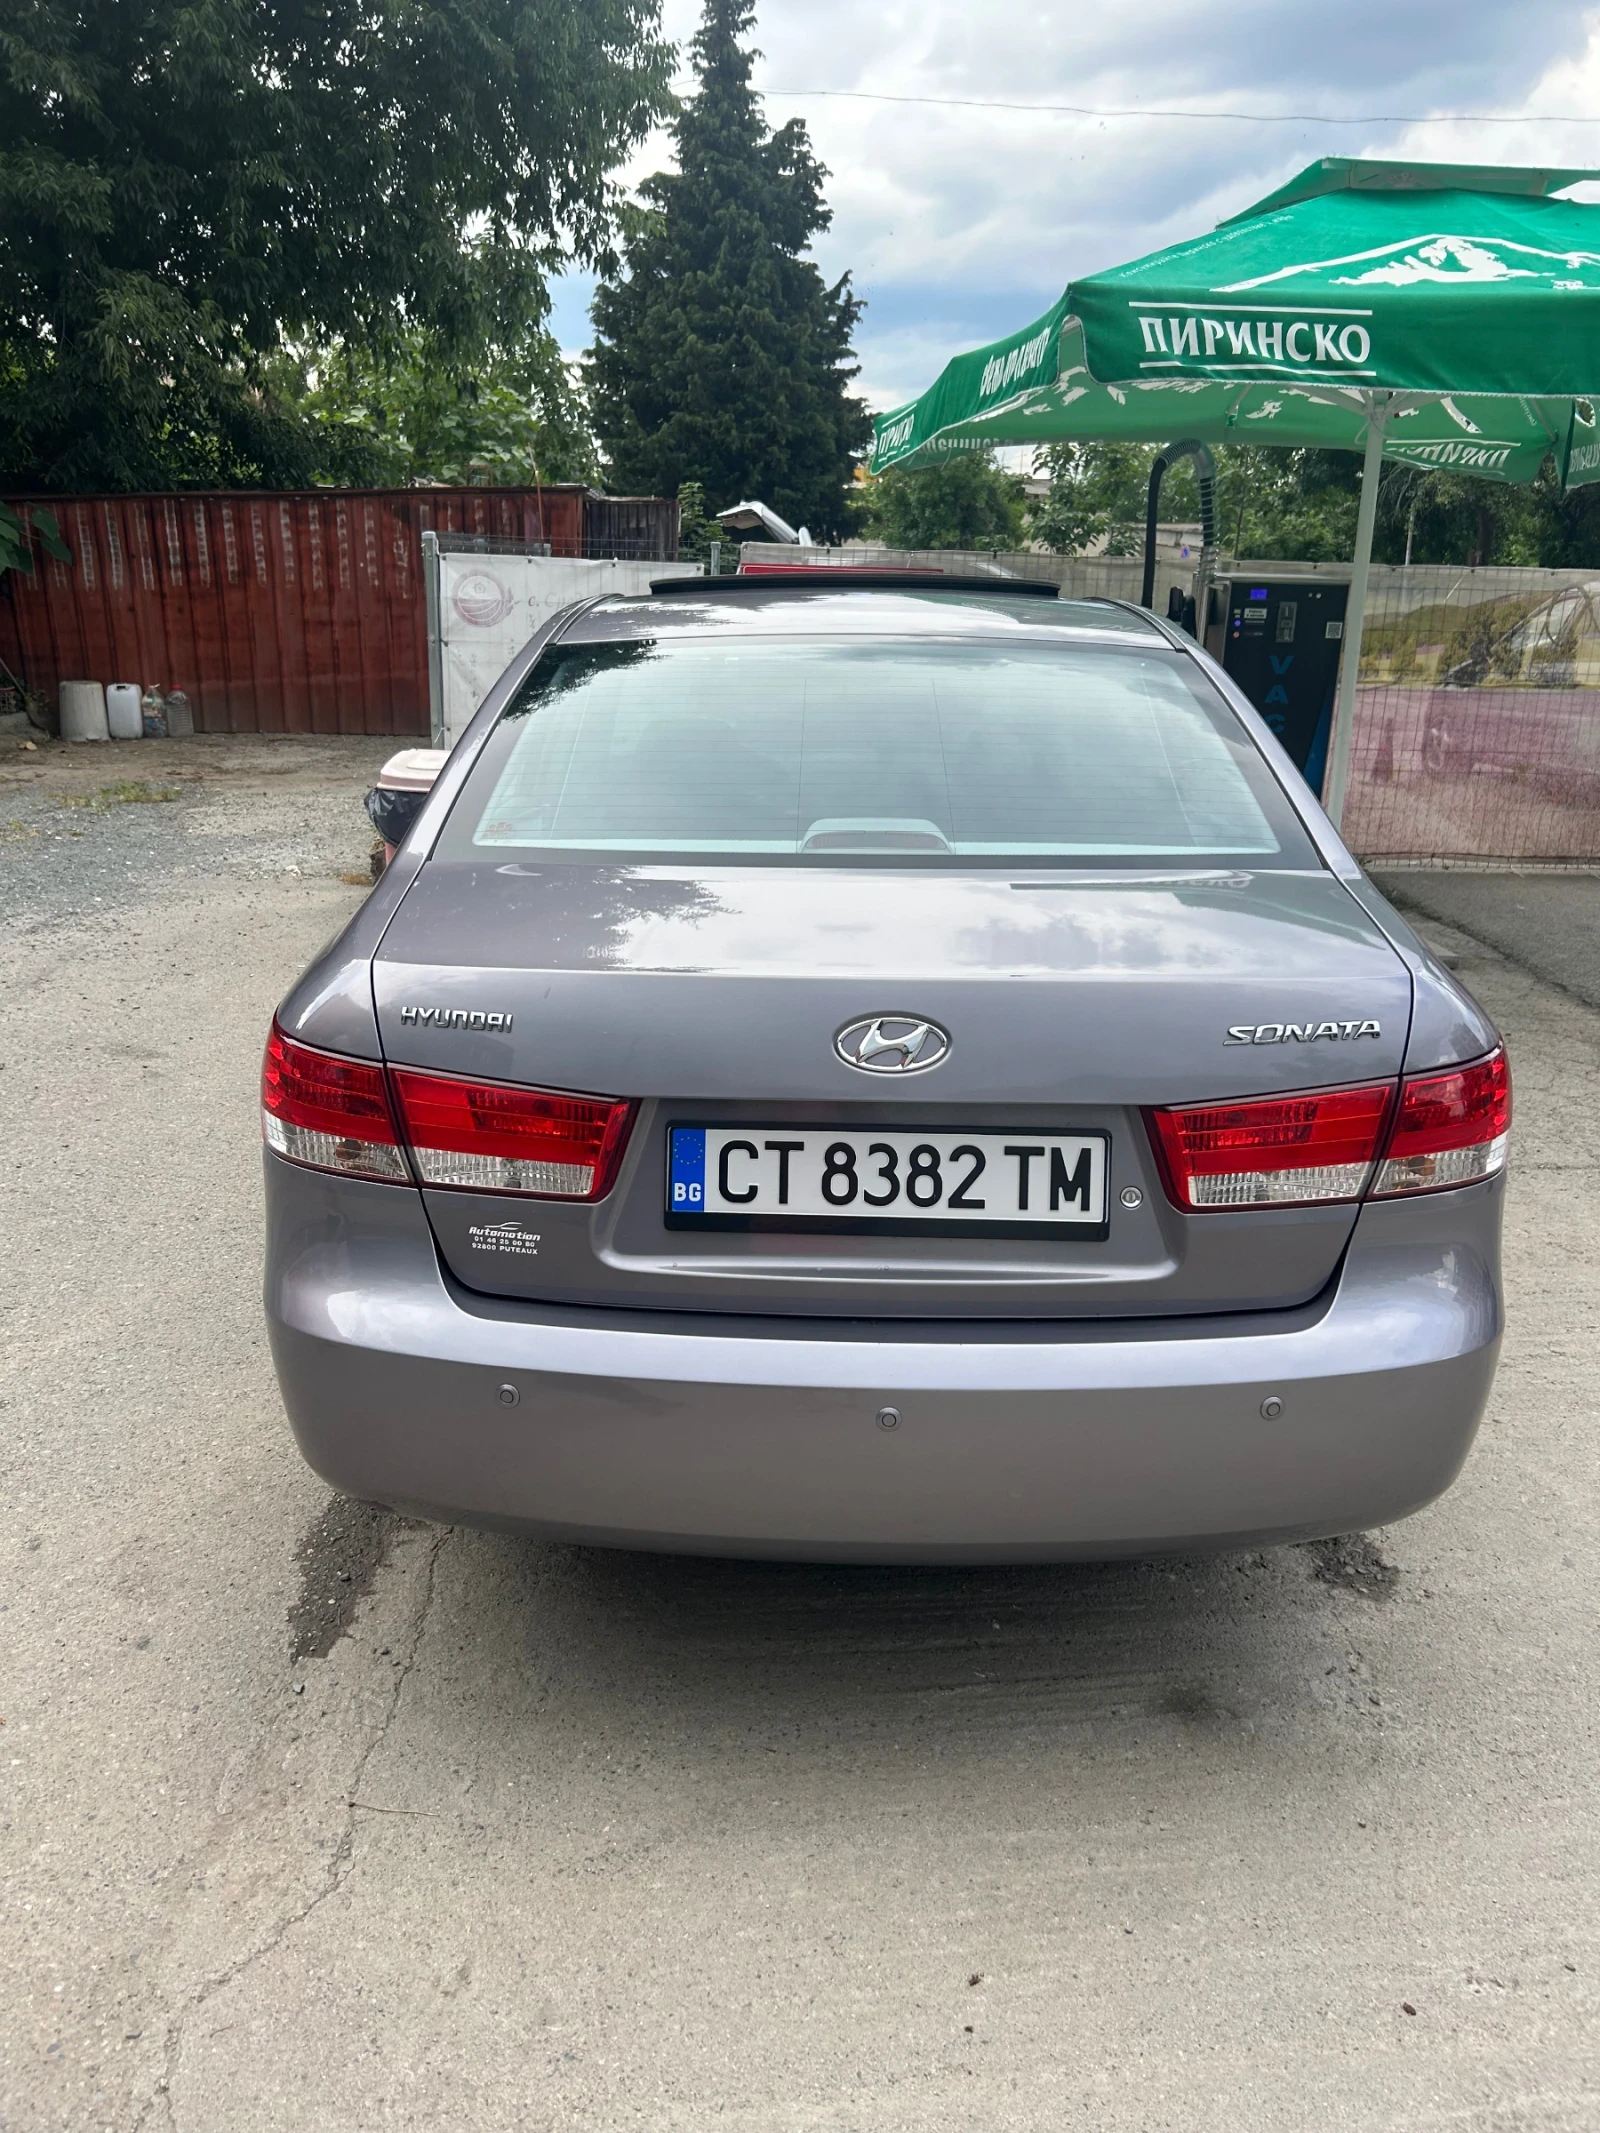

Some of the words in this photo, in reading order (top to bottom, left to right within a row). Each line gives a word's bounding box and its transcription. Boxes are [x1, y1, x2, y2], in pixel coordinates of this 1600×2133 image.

[1138, 316, 1371, 363] ПИРИНСКО
[401, 1006, 513, 1033] HYUNDAI
[1223, 1020, 1381, 1046] SONATA
[718, 1140, 805, 1205] CT
[821, 1142, 987, 1209] 8382
[1004, 1145, 1092, 1212] TM
[674, 1182, 702, 1202] BG
[469, 1226, 541, 1241] Automotion
[500, 1245, 538, 1255] PUTEAUX
